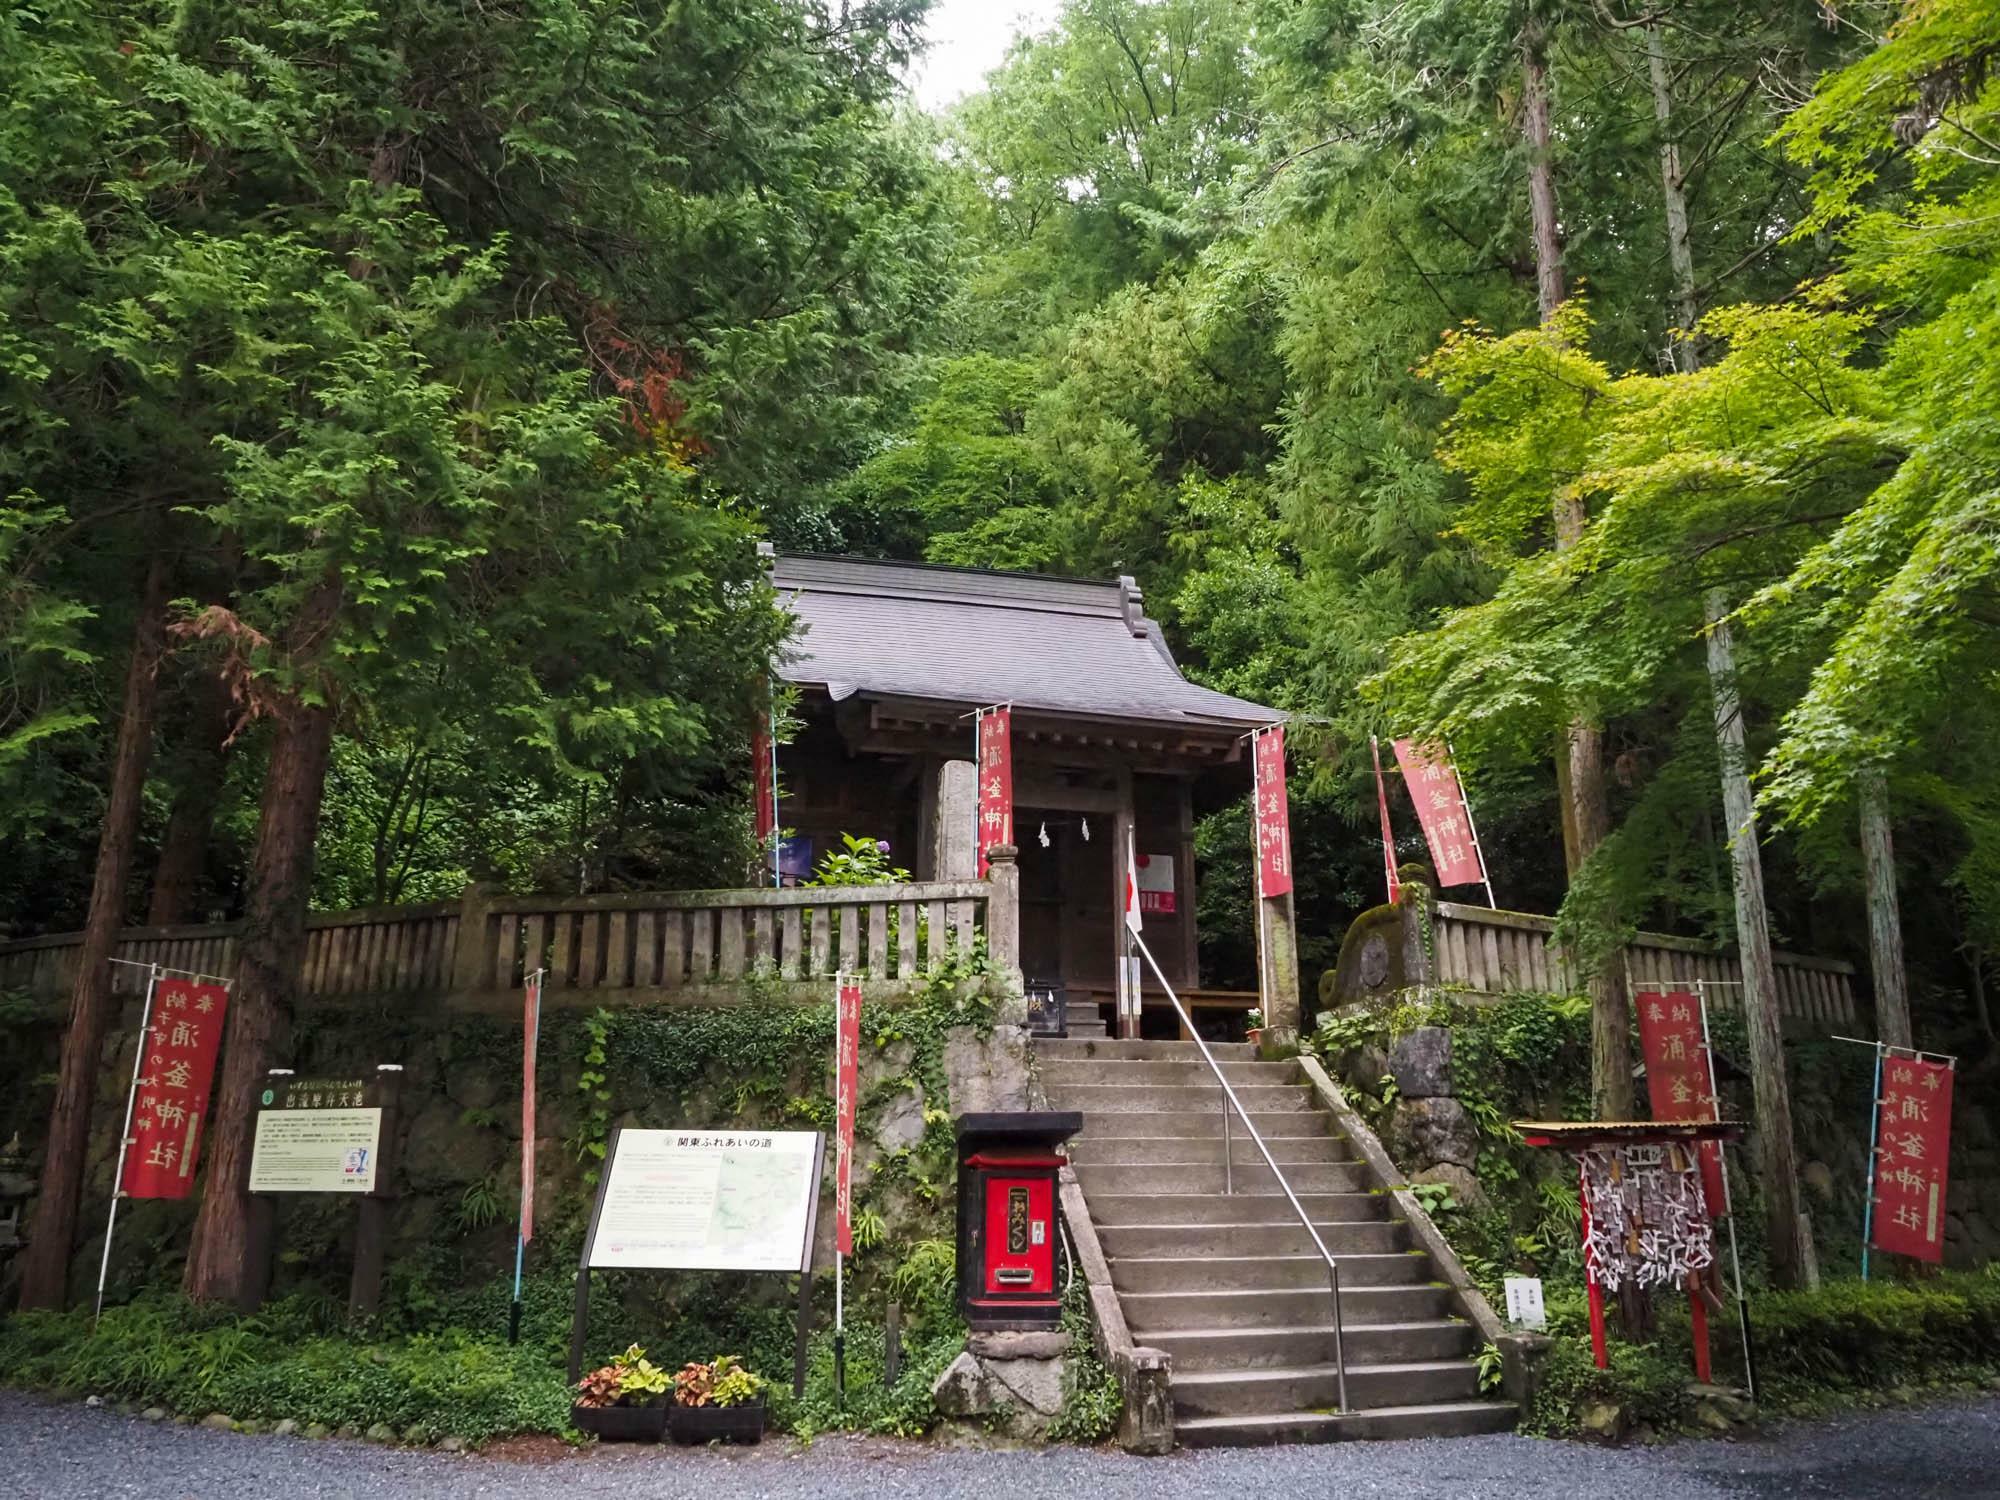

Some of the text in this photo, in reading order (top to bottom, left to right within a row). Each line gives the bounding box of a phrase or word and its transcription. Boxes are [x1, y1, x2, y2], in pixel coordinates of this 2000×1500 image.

[1646, 1002, 1691, 1024] 奉納
[676, 1136, 772, 1148] 関東ふれあいの道
[1011, 1200, 1026, 1249] おみくじ
